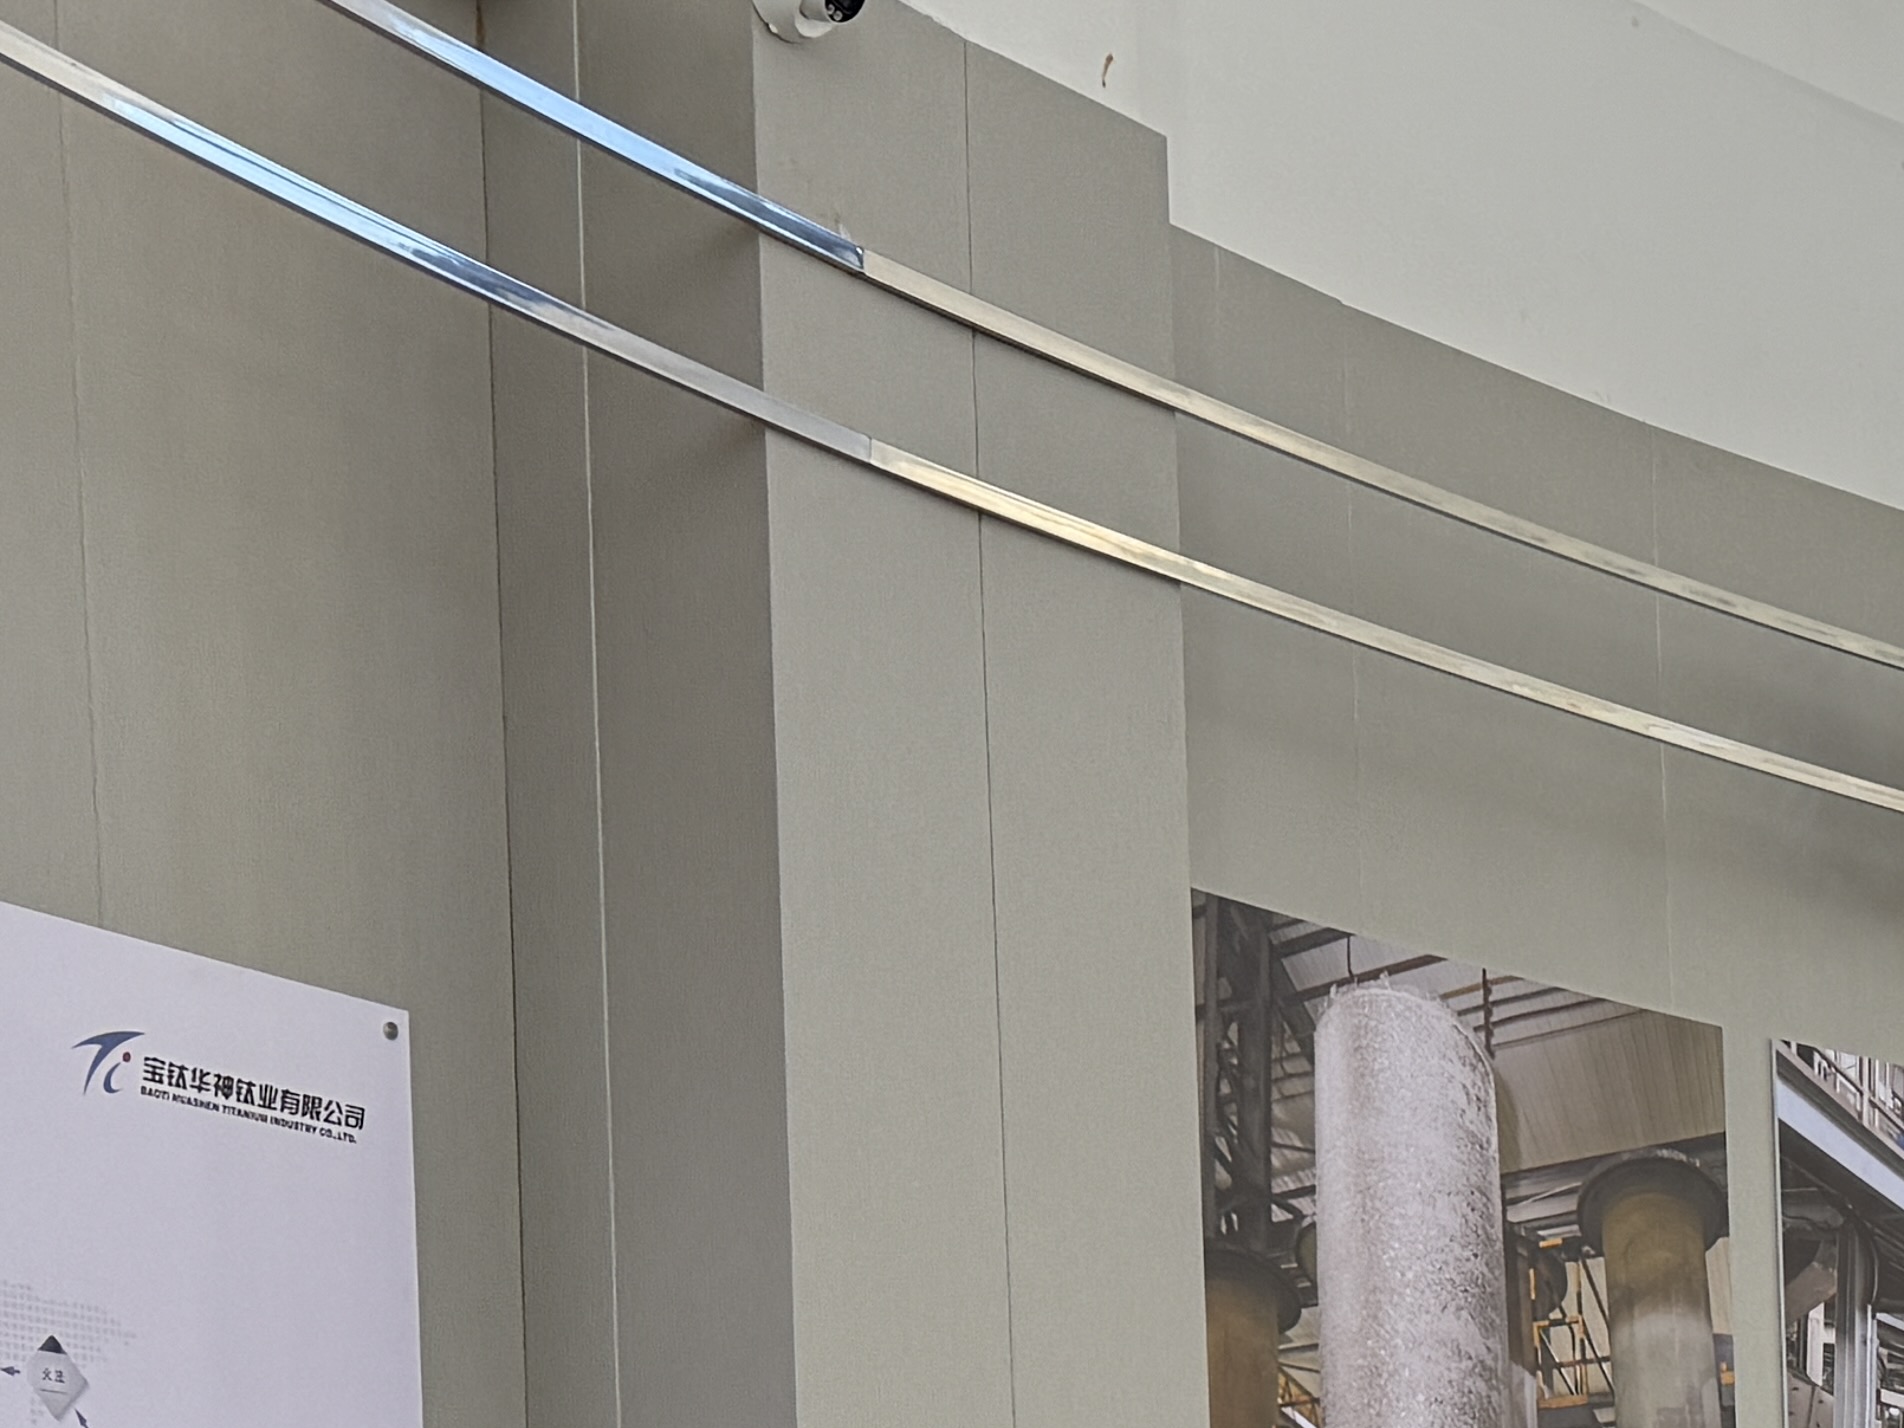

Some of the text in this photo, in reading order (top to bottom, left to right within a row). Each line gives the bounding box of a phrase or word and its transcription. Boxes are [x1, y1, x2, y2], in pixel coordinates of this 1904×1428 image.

[142, 1056, 366, 1131] 宝钛华神钛业有限公司
